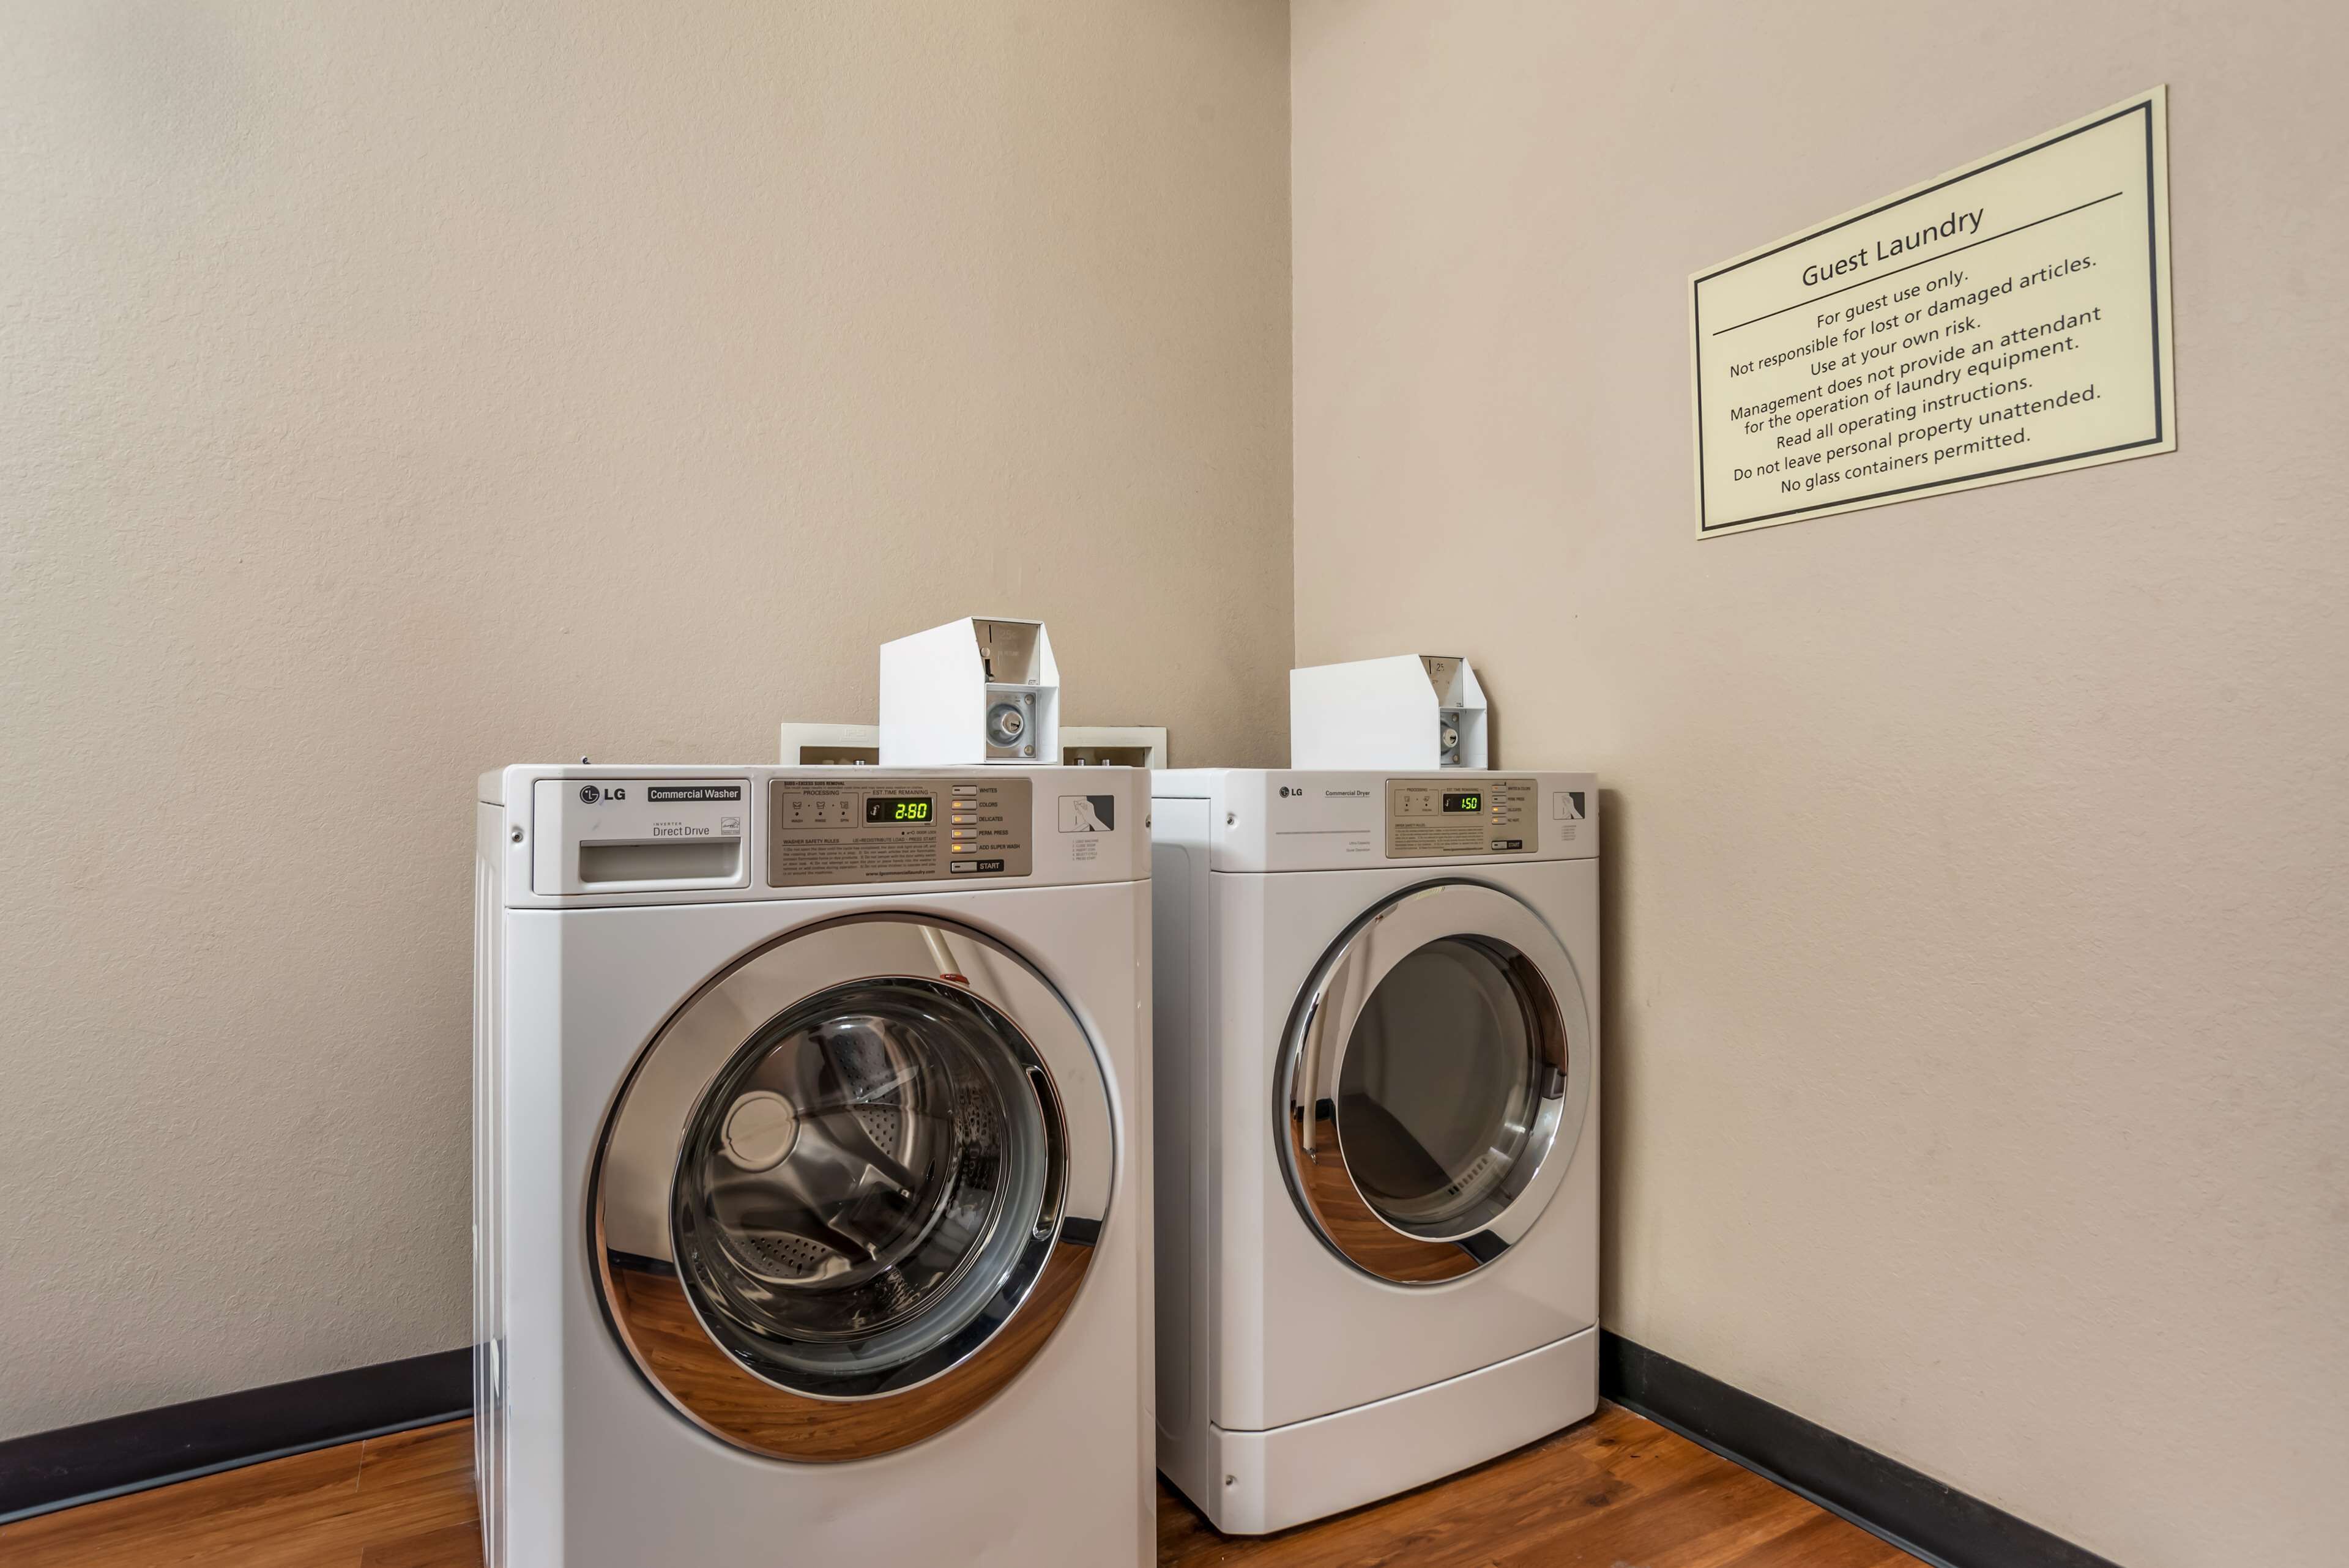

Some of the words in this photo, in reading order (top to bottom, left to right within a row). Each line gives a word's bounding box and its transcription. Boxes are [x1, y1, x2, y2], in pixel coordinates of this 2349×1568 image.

[1802, 248, 1869, 286] Guest
[1877, 207, 1984, 261] Laundry
[1730, 360, 1754, 378] Not
[1759, 335, 1838, 370] responsible
[1842, 327, 1866, 343] for
[1871, 315, 1900, 335] lost
[1904, 309, 1923, 324] or
[1927, 277, 2012, 317] damaged
[2019, 256, 2096, 289] articles.
[1817, 311, 1841, 329] For
[1845, 294, 1888, 322] guest
[1894, 286, 1921, 303] use
[1926, 270, 1968, 292] only.
[1730, 385, 1823, 422] Management
[1827, 376, 1863, 395] does
[1867, 365, 1895, 384] not
[1900, 346, 1965, 379] provide
[1971, 340, 1993, 355] an
[2000, 307, 2102, 347] attendant
[1811, 360, 1836, 376] Use
[1841, 352, 1857, 367] at
[1861, 341, 1897, 365] your
[1902, 330, 1939, 349] own
[1945, 316, 1981, 337] risk.
[1744, 421, 1765, 435] for
[1768, 414, 1792, 429] the
[1796, 393, 1869, 423] operation
[1874, 382, 1891, 401] of
[1897, 368, 1962, 395] laundry
[1967, 336, 2079, 376] equipment.
[1777, 428, 1811, 449] Read
[1816, 422, 1833, 439] all
[1838, 406, 1916, 435] operating
[1923, 377, 2033, 414] instructions.
[1734, 469, 1752, 481] Do
[1757, 460, 1781, 477] not
[1784, 453, 1822, 470] leave
[1826, 432, 1892, 464] personal
[1898, 417, 1973, 448] property
[1979, 384, 2101, 425] unattended.
[1781, 479, 1801, 494] No
[1805, 472, 1841, 492] glass
[1845, 452, 1929, 480] containers
[1934, 427, 2030, 465] permitted.
[604, 787, 626, 800] LG
[650, 789, 703, 800] Commercial
[705, 789, 739, 799] Washer
[653, 827, 682, 836] Direct
[685, 827, 710, 836] Drive
